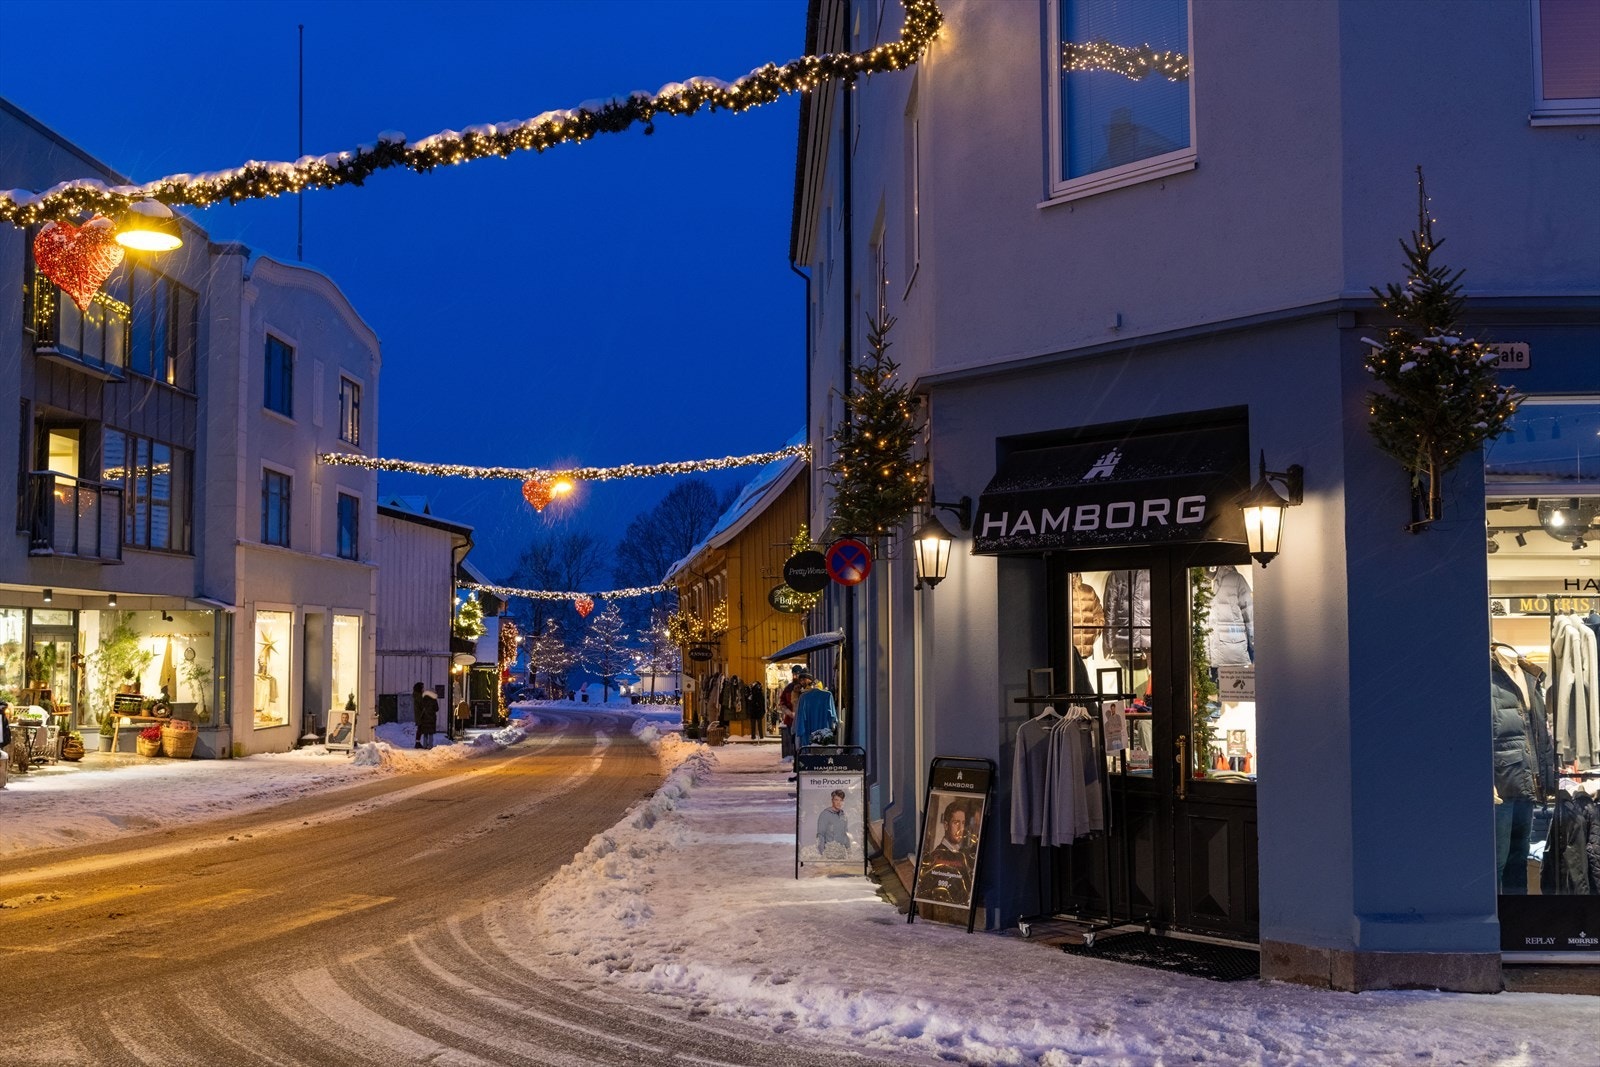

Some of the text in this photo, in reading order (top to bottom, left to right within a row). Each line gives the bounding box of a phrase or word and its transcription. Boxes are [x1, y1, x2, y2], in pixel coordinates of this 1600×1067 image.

[981, 495, 1206, 537] HAMBORG
[943, 781, 974, 789] HAMBORG
[1525, 937, 1556, 945] REPLAY
